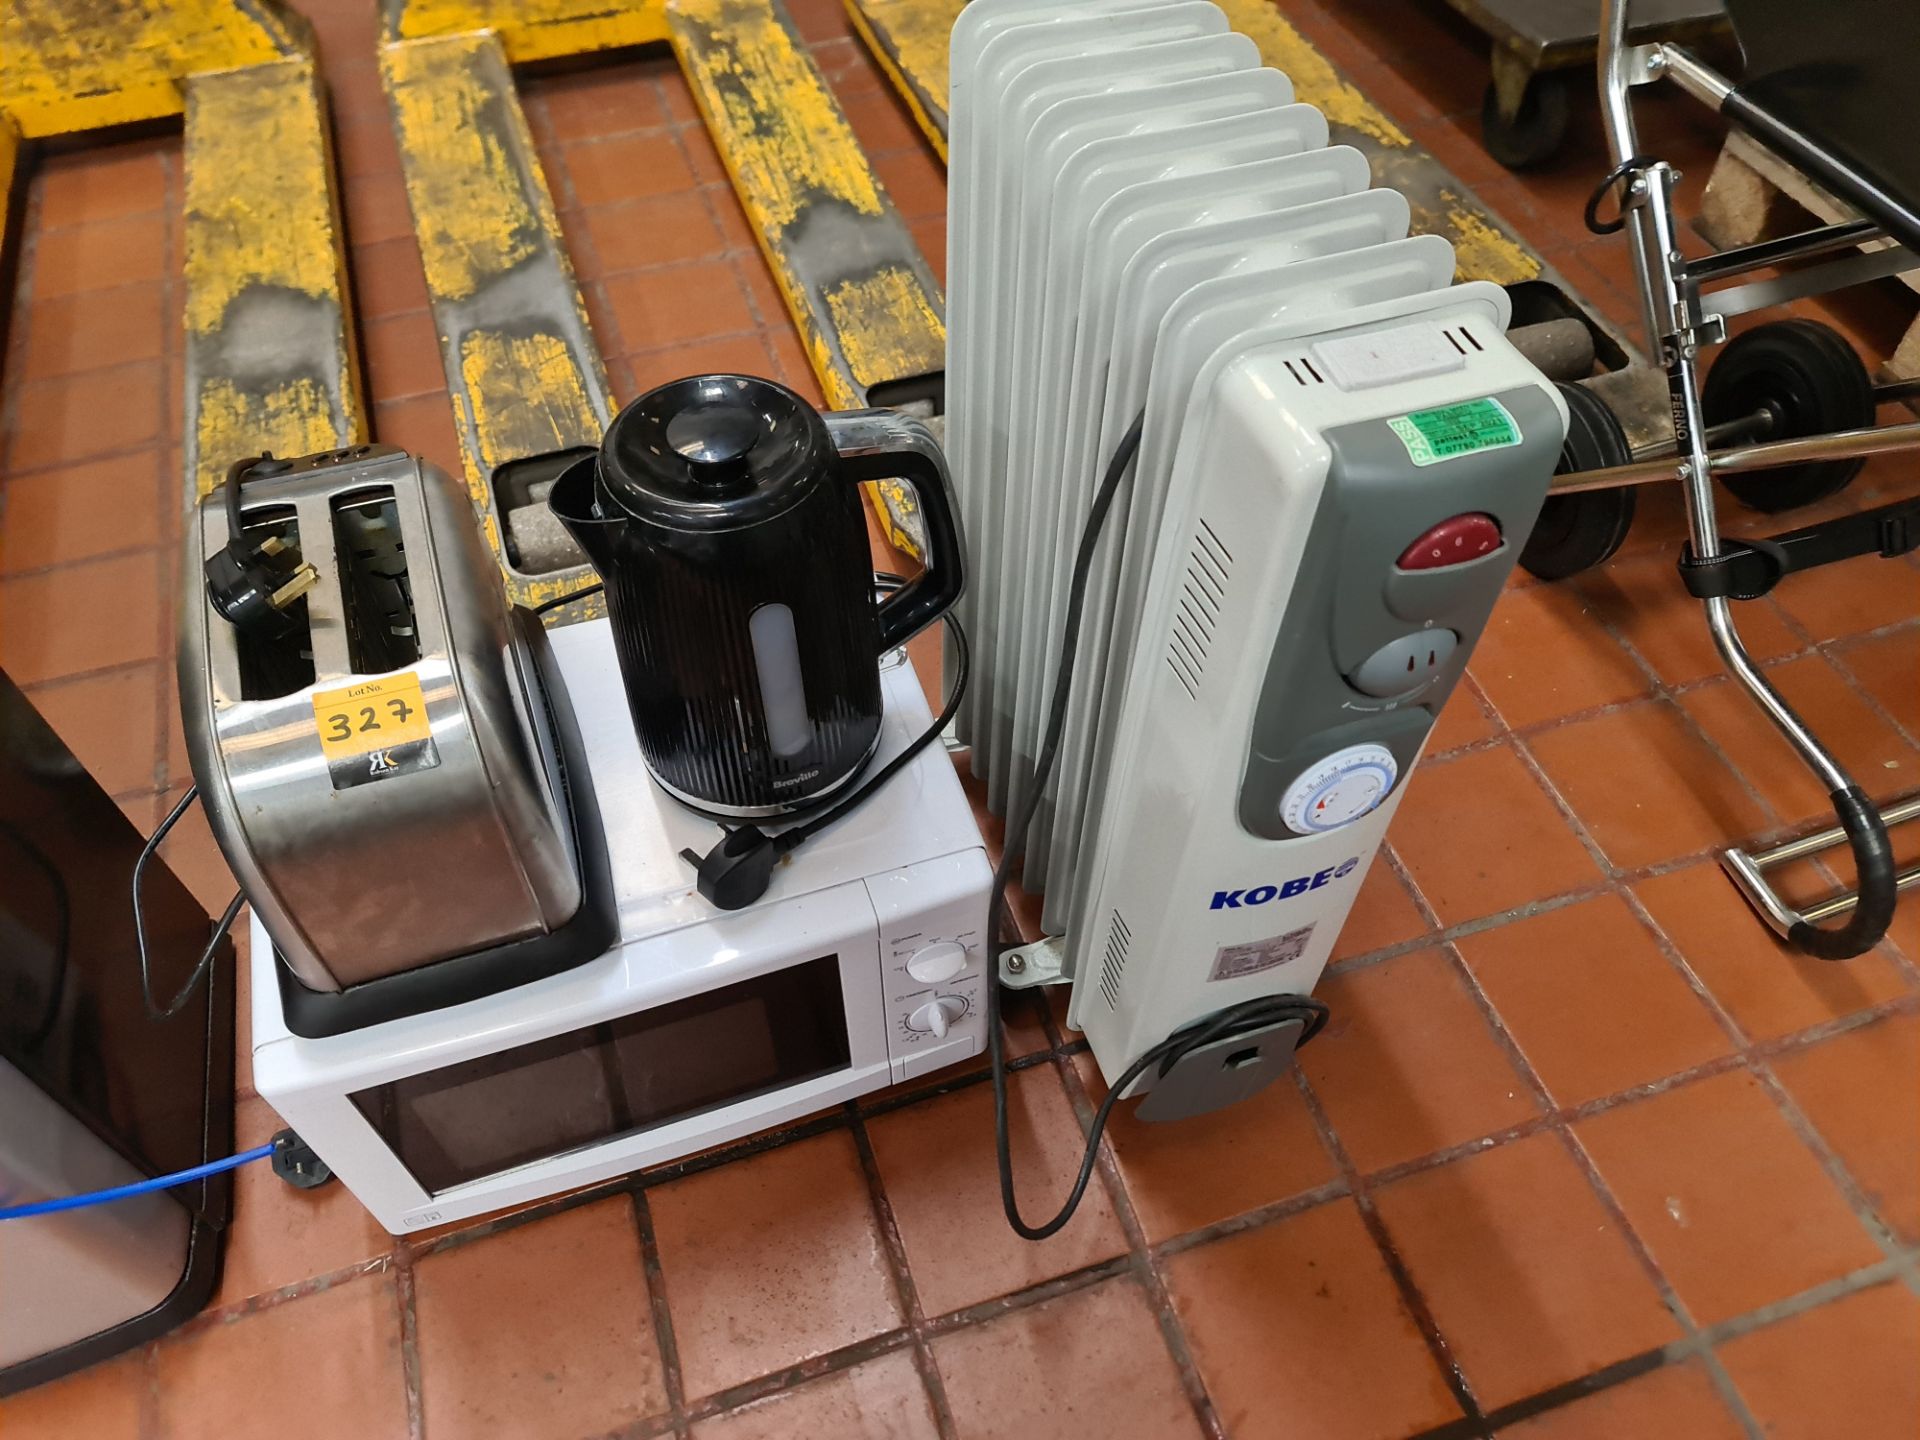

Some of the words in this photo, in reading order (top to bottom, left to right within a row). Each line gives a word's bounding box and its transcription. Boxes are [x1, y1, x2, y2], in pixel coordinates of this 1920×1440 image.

[1671, 392, 1688, 440] FERNO
[1393, 419, 1430, 461] PASS
[349, 688, 364, 697] Lot
[366, 684, 383, 694] No.
[327, 699, 413, 742] 327
[773, 769, 819, 788] Breville
[1209, 866, 1336, 909] KOBE
